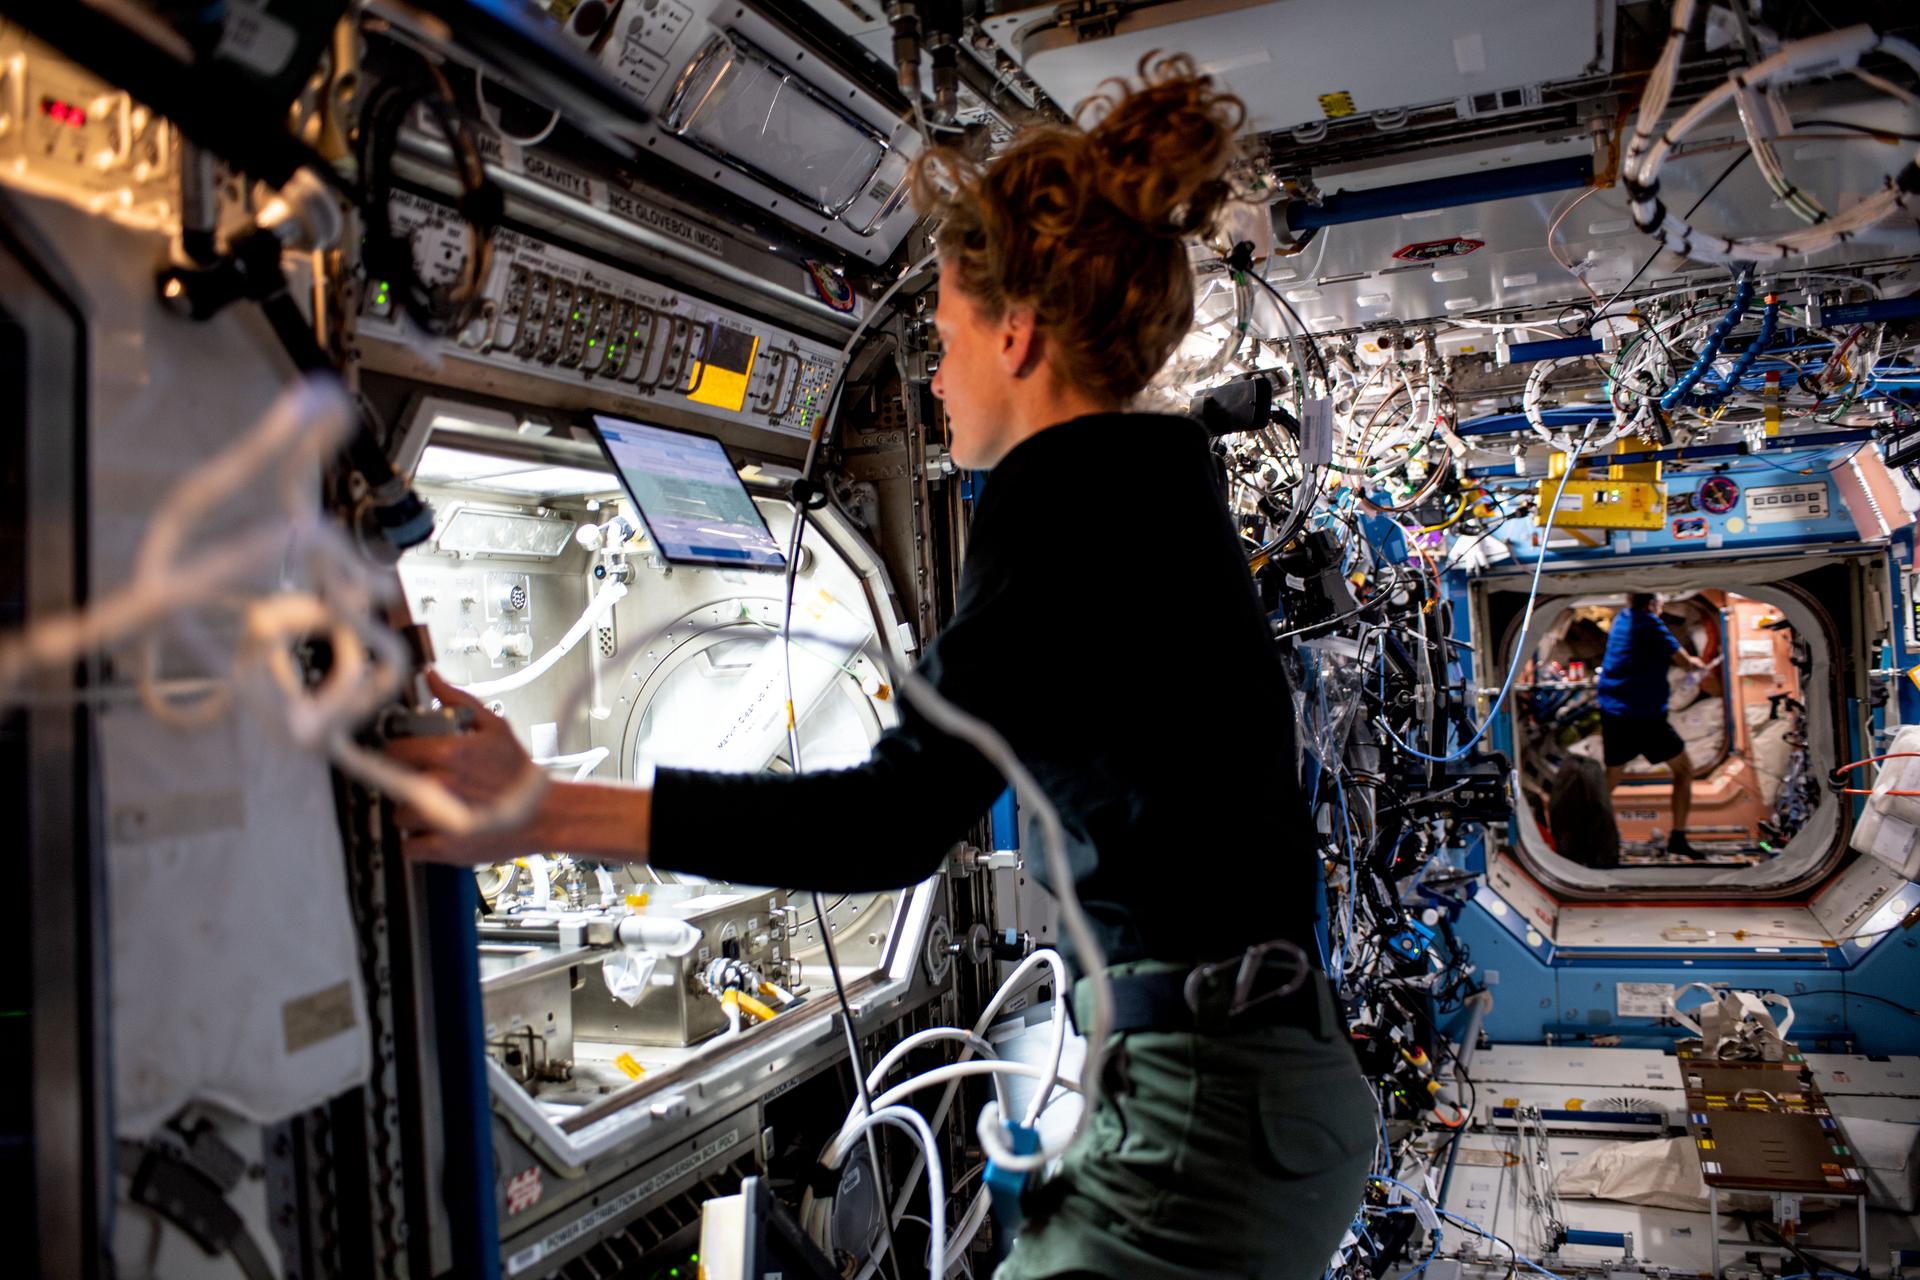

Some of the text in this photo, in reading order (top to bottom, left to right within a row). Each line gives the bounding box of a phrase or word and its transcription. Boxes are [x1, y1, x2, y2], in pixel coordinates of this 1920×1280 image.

[635, 203, 693, 240] GLOVEBOX
[546, 1222, 580, 1247] POWER
[581, 1193, 638, 1232] DISTRIBUTION
[638, 1182, 654, 1200] AND
[655, 1153, 702, 1189] CONVERSION
